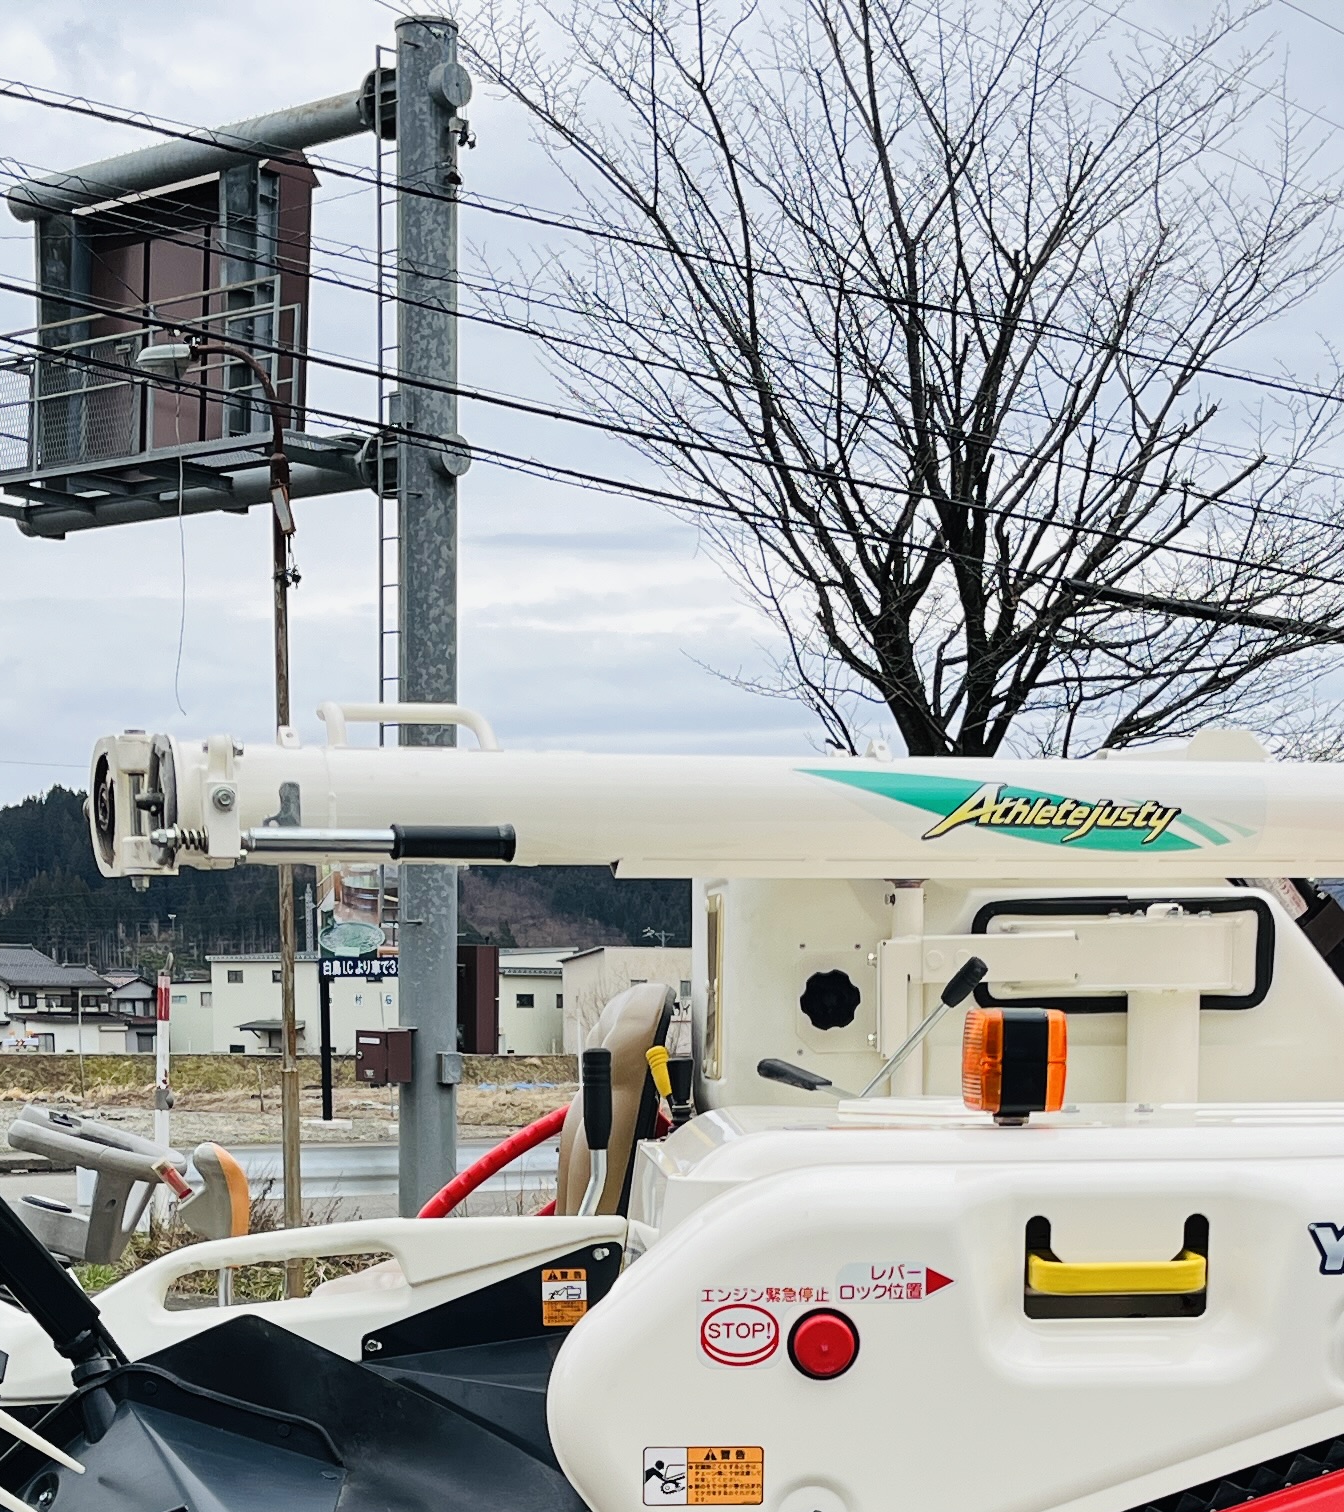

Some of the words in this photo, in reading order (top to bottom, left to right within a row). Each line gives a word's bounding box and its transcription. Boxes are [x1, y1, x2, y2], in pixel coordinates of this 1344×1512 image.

[921, 782, 1182, 845] Athletejusty
[872, 1264, 922, 1280] レバー
[701, 1287, 830, 1302] エンジン緊急停止
[840, 1283, 923, 1300] ロック位置
[708, 1322, 772, 1340] STOP!
